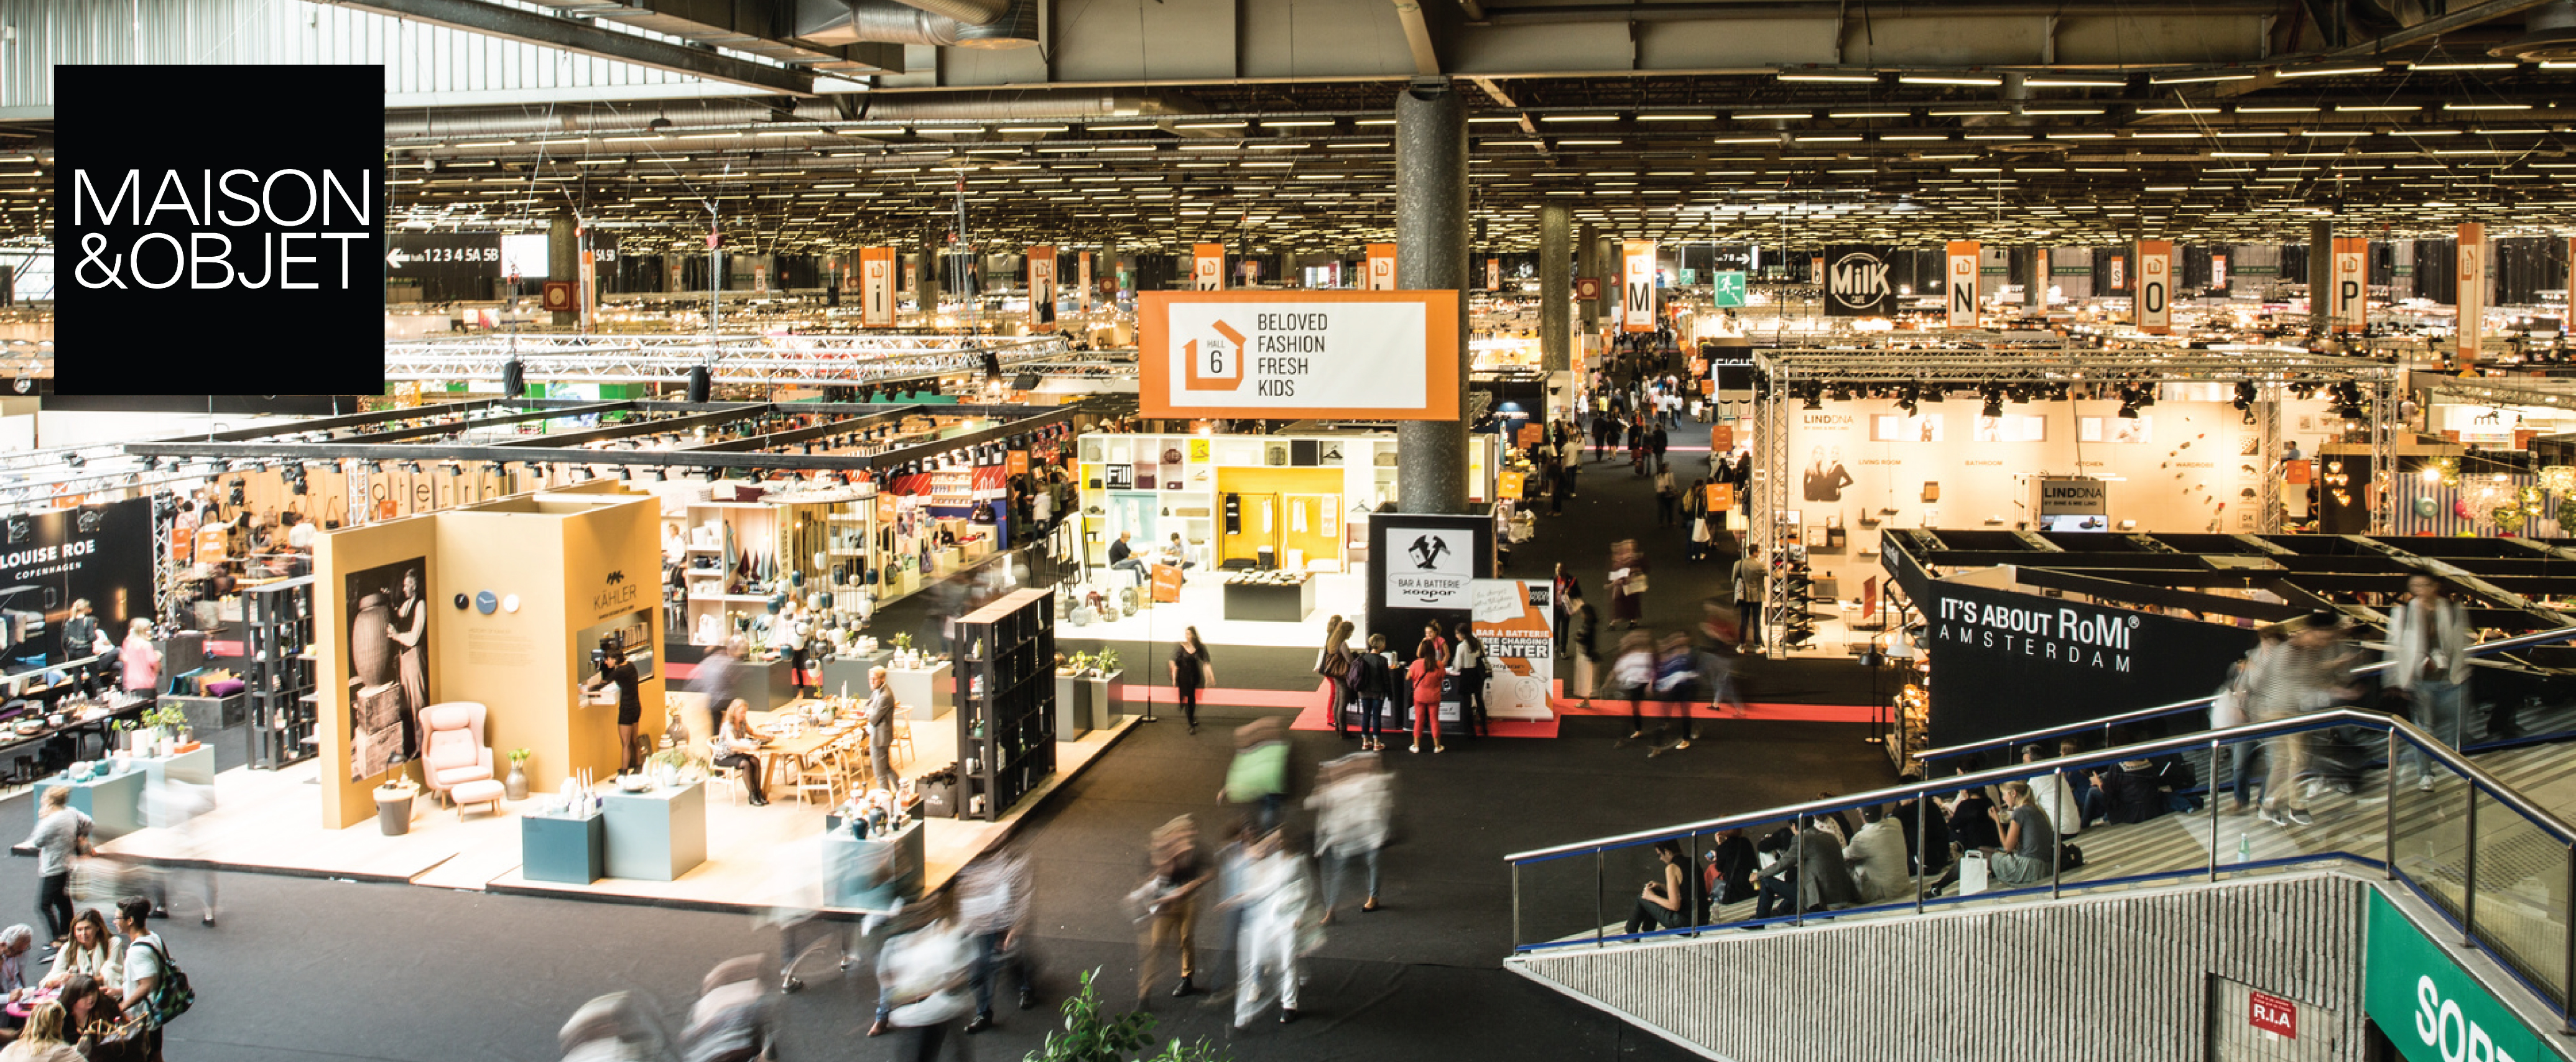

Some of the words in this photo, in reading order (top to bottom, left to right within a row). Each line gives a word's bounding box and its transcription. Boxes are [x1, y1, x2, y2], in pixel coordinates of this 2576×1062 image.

[424, 248, 430, 262] 1
[433, 249, 441, 262] 2
[443, 249, 452, 262] 3
[454, 248, 463, 262] 4
[465, 249, 481, 262] 5A
[483, 249, 499, 262] 5B
[1830, 264, 1891, 295] MilK
[2114, 270, 2121, 283] S
[1629, 283, 1649, 312] M
[1955, 282, 1972, 313] N
[2146, 281, 2163, 312] O
[2342, 280, 2358, 310] P
[1258, 313, 1328, 331] BELOVED
[1207, 340, 1225, 348] HALL
[1258, 335, 1325, 353] FASHION
[1210, 350, 1223, 374] 6
[1258, 357, 1309, 375] FRESH
[1258, 379, 1294, 397] KIDS
[1804, 415, 1854, 423] LINDDNA
[2044, 487, 2103, 498] LINDDNA
[0, 545, 57, 570] LOUISE
[62, 538, 95, 558] ROE
[15, 560, 82, 580] COPENHAGEN
[1398, 578, 1414, 587] BAR
[1424, 579, 1460, 589] BATTERIE
[1940, 597, 1977, 624] IT'S
[1981, 604, 2053, 637] ABOUT
[1939, 624, 2129, 673] AMSTERDAM
[2254, 1004, 2291, 1028] R.I.A
[2415, 974, 2517, 1062] SOR
